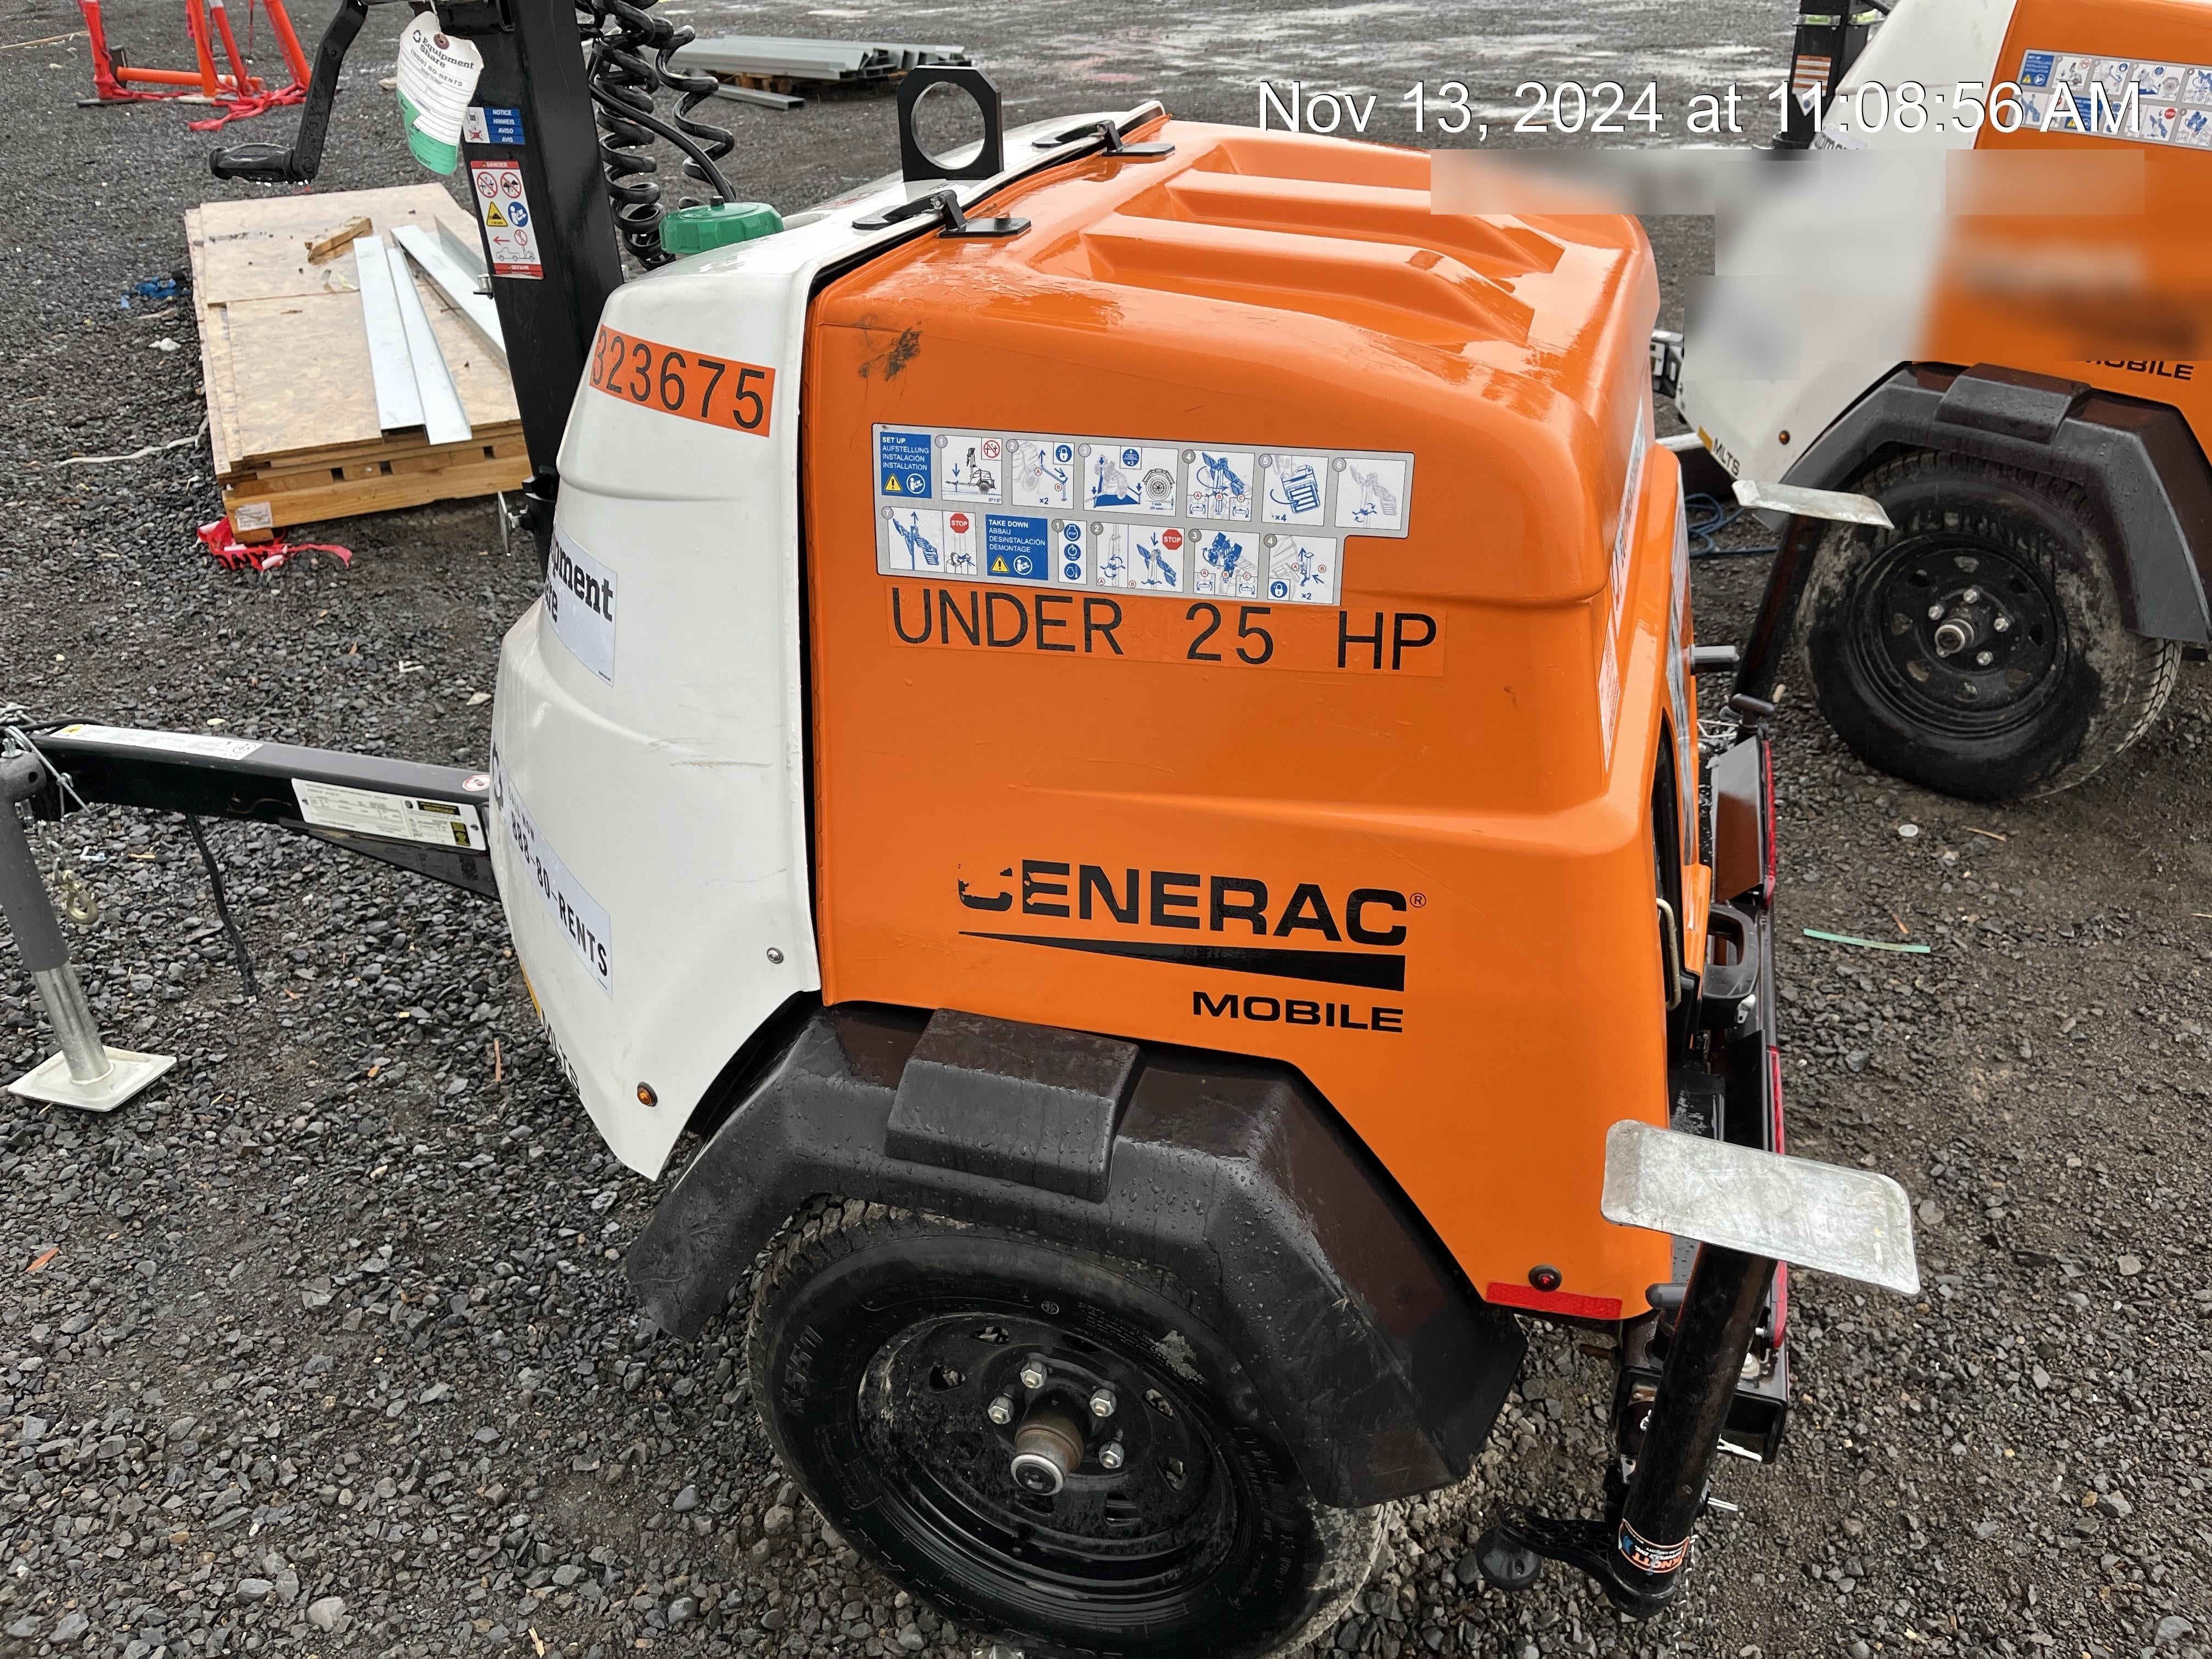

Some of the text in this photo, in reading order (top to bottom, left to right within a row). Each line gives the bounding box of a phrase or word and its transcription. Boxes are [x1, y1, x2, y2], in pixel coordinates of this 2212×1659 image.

[420, 44, 445, 68] Share
[422, 37, 475, 69] Equipment
[592, 330, 765, 429] 323675
[882, 445, 929, 454] AUFSTELLUNG
[882, 453, 925, 462] INSTALACIÓN
[1713, 437, 1741, 476] MLTS
[883, 461, 928, 471] INSTALLATION
[989, 535, 1046, 546] DESINSTALACIÓN
[989, 543, 1031, 553] DÉMONTAGE
[893, 589, 1436, 670] UNDER 25 HP
[511, 810, 607, 977] 888-80-RENTS
[1193, 991, 1404, 1034] MOBILE
